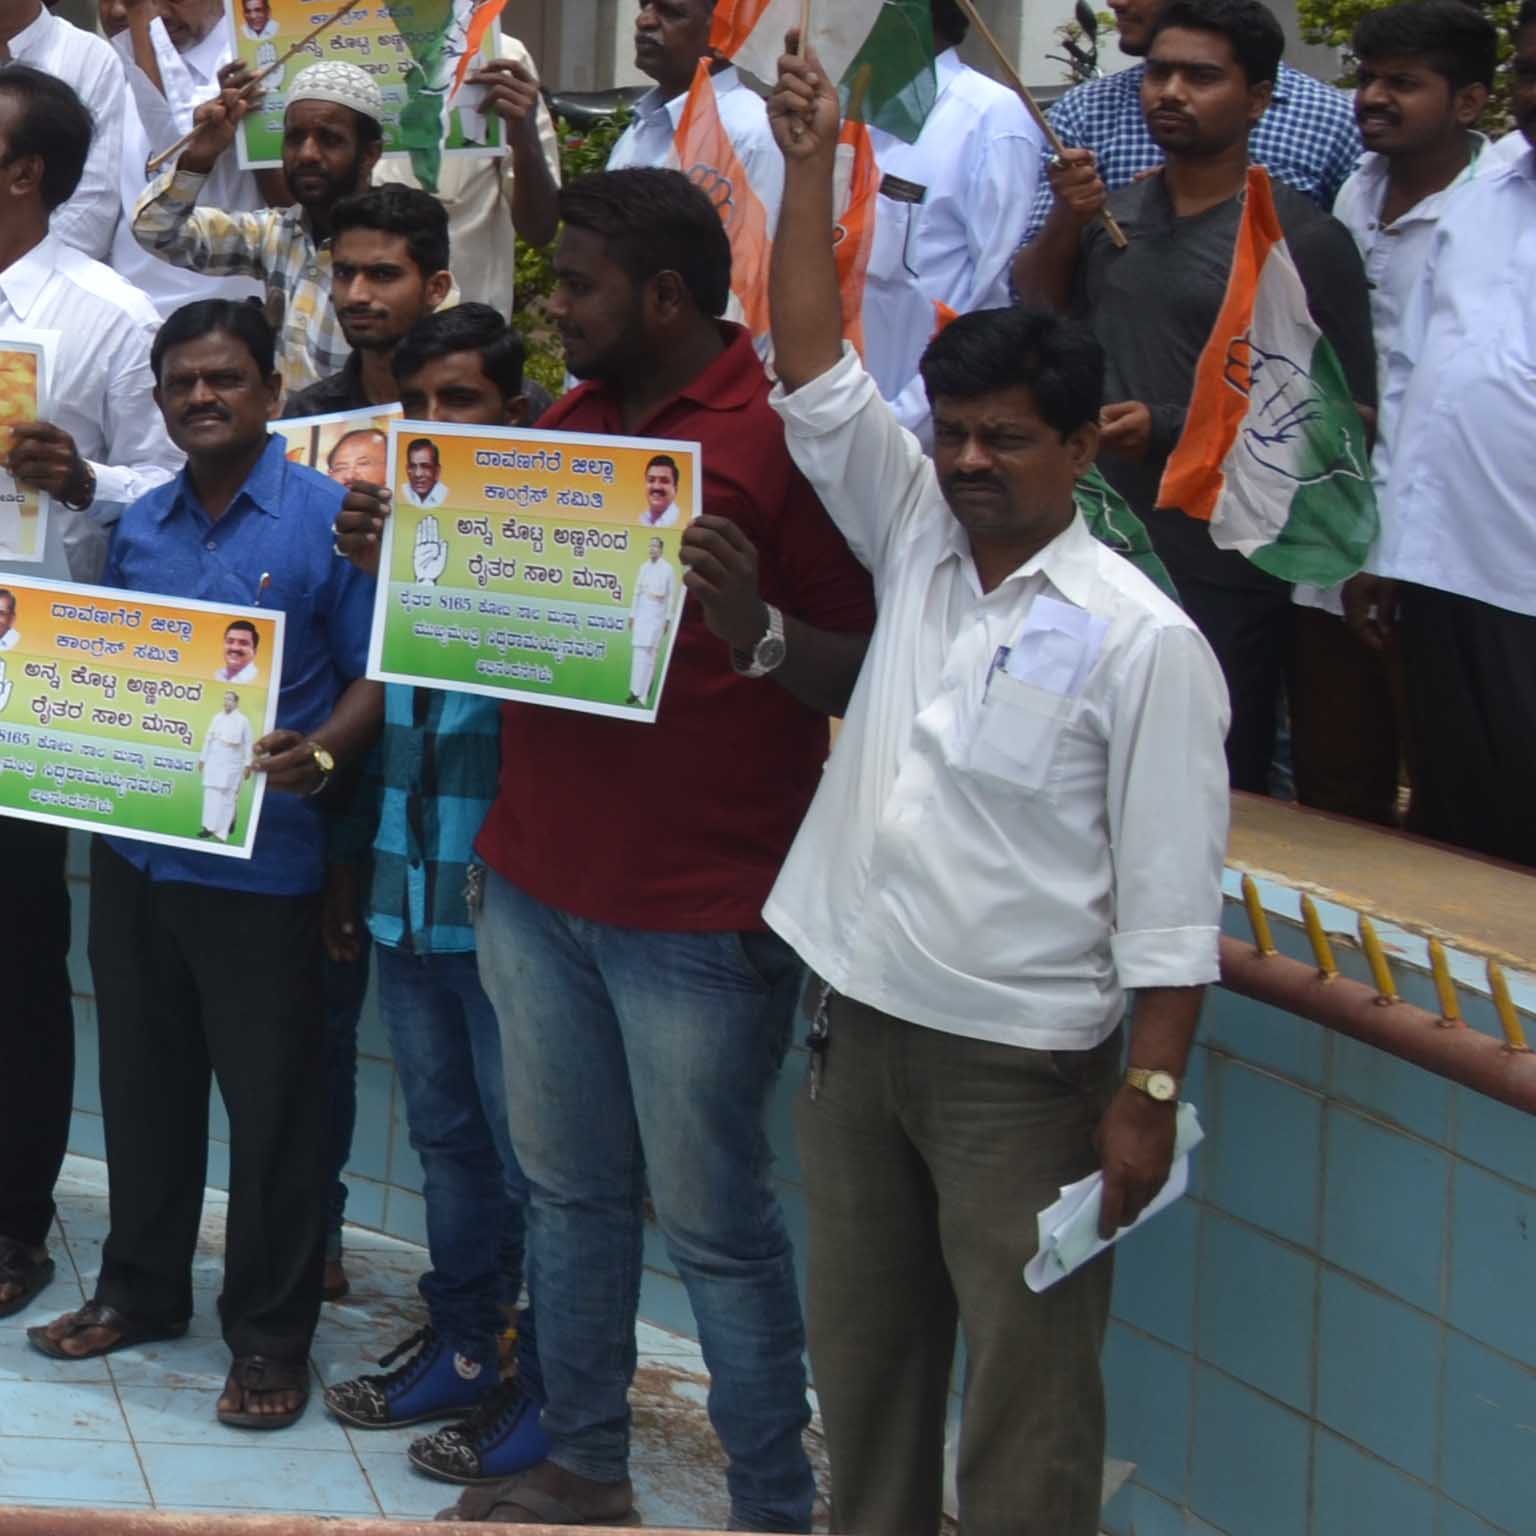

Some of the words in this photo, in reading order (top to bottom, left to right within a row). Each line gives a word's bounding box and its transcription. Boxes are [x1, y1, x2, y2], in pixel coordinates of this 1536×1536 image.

[330, 36, 371, 54] ಕೊಟ್ಟ
[476, 449, 561, 472] ದಾವಣಗೆರೆ
[571, 459, 614, 482] ಜಿಲ್ಲಾ
[485, 484, 548, 505] ಕಾಂಗ್ರೆಸ್
[557, 491, 603, 508] ಸಮಿತಿ
[458, 517, 493, 545] ಅನ್ನ
[502, 518, 543, 553] ಕೊಟ್ಟ
[554, 527, 629, 555] ಅಣ್ಣನಿಂದ
[469, 555, 515, 585] ರೈತರ
[524, 564, 563, 583] ಸಾಲ
[572, 569, 622, 600] ಮನ್ನಾ
[439, 595, 472, 611] 8165
[52, 602, 142, 628] ದಾವಣಗೆರೆ
[150, 617, 193, 640] ಜಿಲ್ಲಾ
[57, 635, 125, 656] ಕಾಂಗ್ರೆಸ್
[134, 645, 179, 663] ಸಮಿತಿ
[24, 661, 60, 686] ಅನ್ನ
[72, 666, 117, 696] ಕೊಟ್ಟ
[127, 675, 202, 703] ಅಣ್ಣನಿಂದ
[31, 697, 82, 723] ರೈತರ
[92, 707, 132, 726] ಸಾಲ
[142, 713, 192, 743] ಮನ್ನಾ
